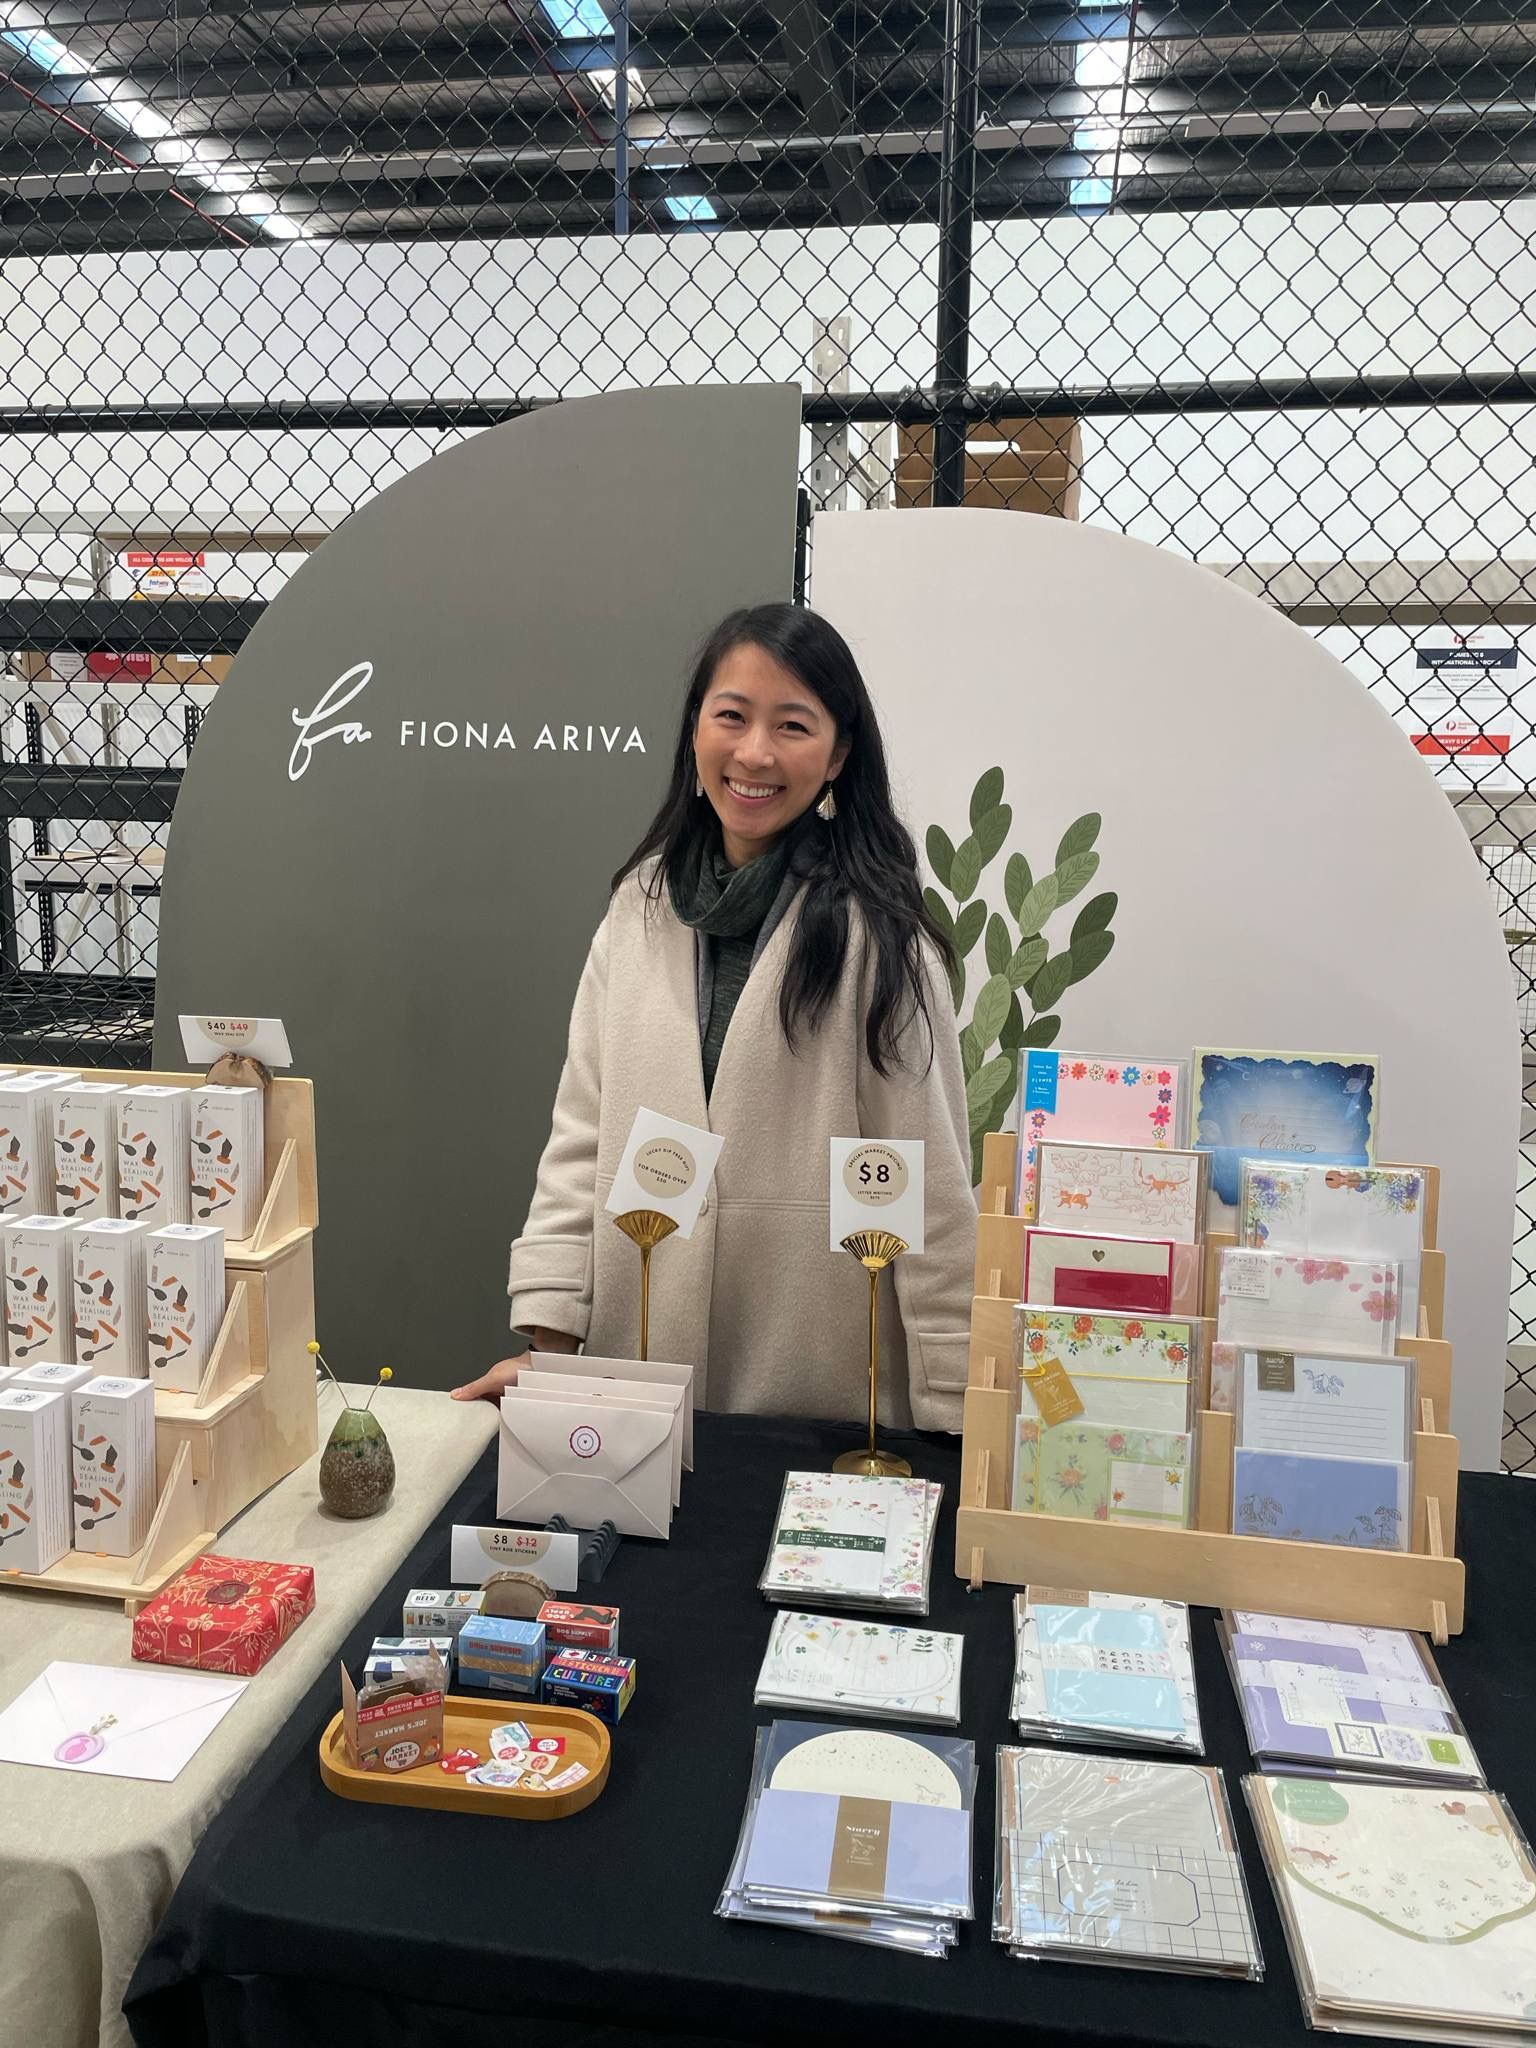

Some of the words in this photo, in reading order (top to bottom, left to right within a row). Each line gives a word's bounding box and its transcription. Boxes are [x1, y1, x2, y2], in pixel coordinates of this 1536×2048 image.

[400, 720, 516, 749] FIONA
[532, 723, 647, 753] ARIVA
[206, 1021, 227, 1031] $40
[848, 1152, 864, 1168] SPECIAL
[886, 1152, 902, 1171] PRICING
[60, 1164, 93, 1173] SEALING
[123, 1167, 154, 1177] SEALING
[197, 1166, 229, 1174] SEALING
[858, 1161, 890, 1185] $8
[650, 1167, 671, 1179] ORDERS
[672, 1176, 687, 1185] OVER
[12, 1302, 46, 1312] SEALING
[79, 1306, 112, 1316] SEALING
[152, 1304, 169, 1312] WAX
[152, 1312, 185, 1323] SEALING
[80, 1473, 114, 1483] SEALING
[493, 1534, 508, 1544] $8
[516, 1536, 537, 1547] $12
[553, 1668, 614, 1688] CULTURE
[391, 1744, 413, 1755] JOE'S
[385, 1749, 418, 1763] MARKET
